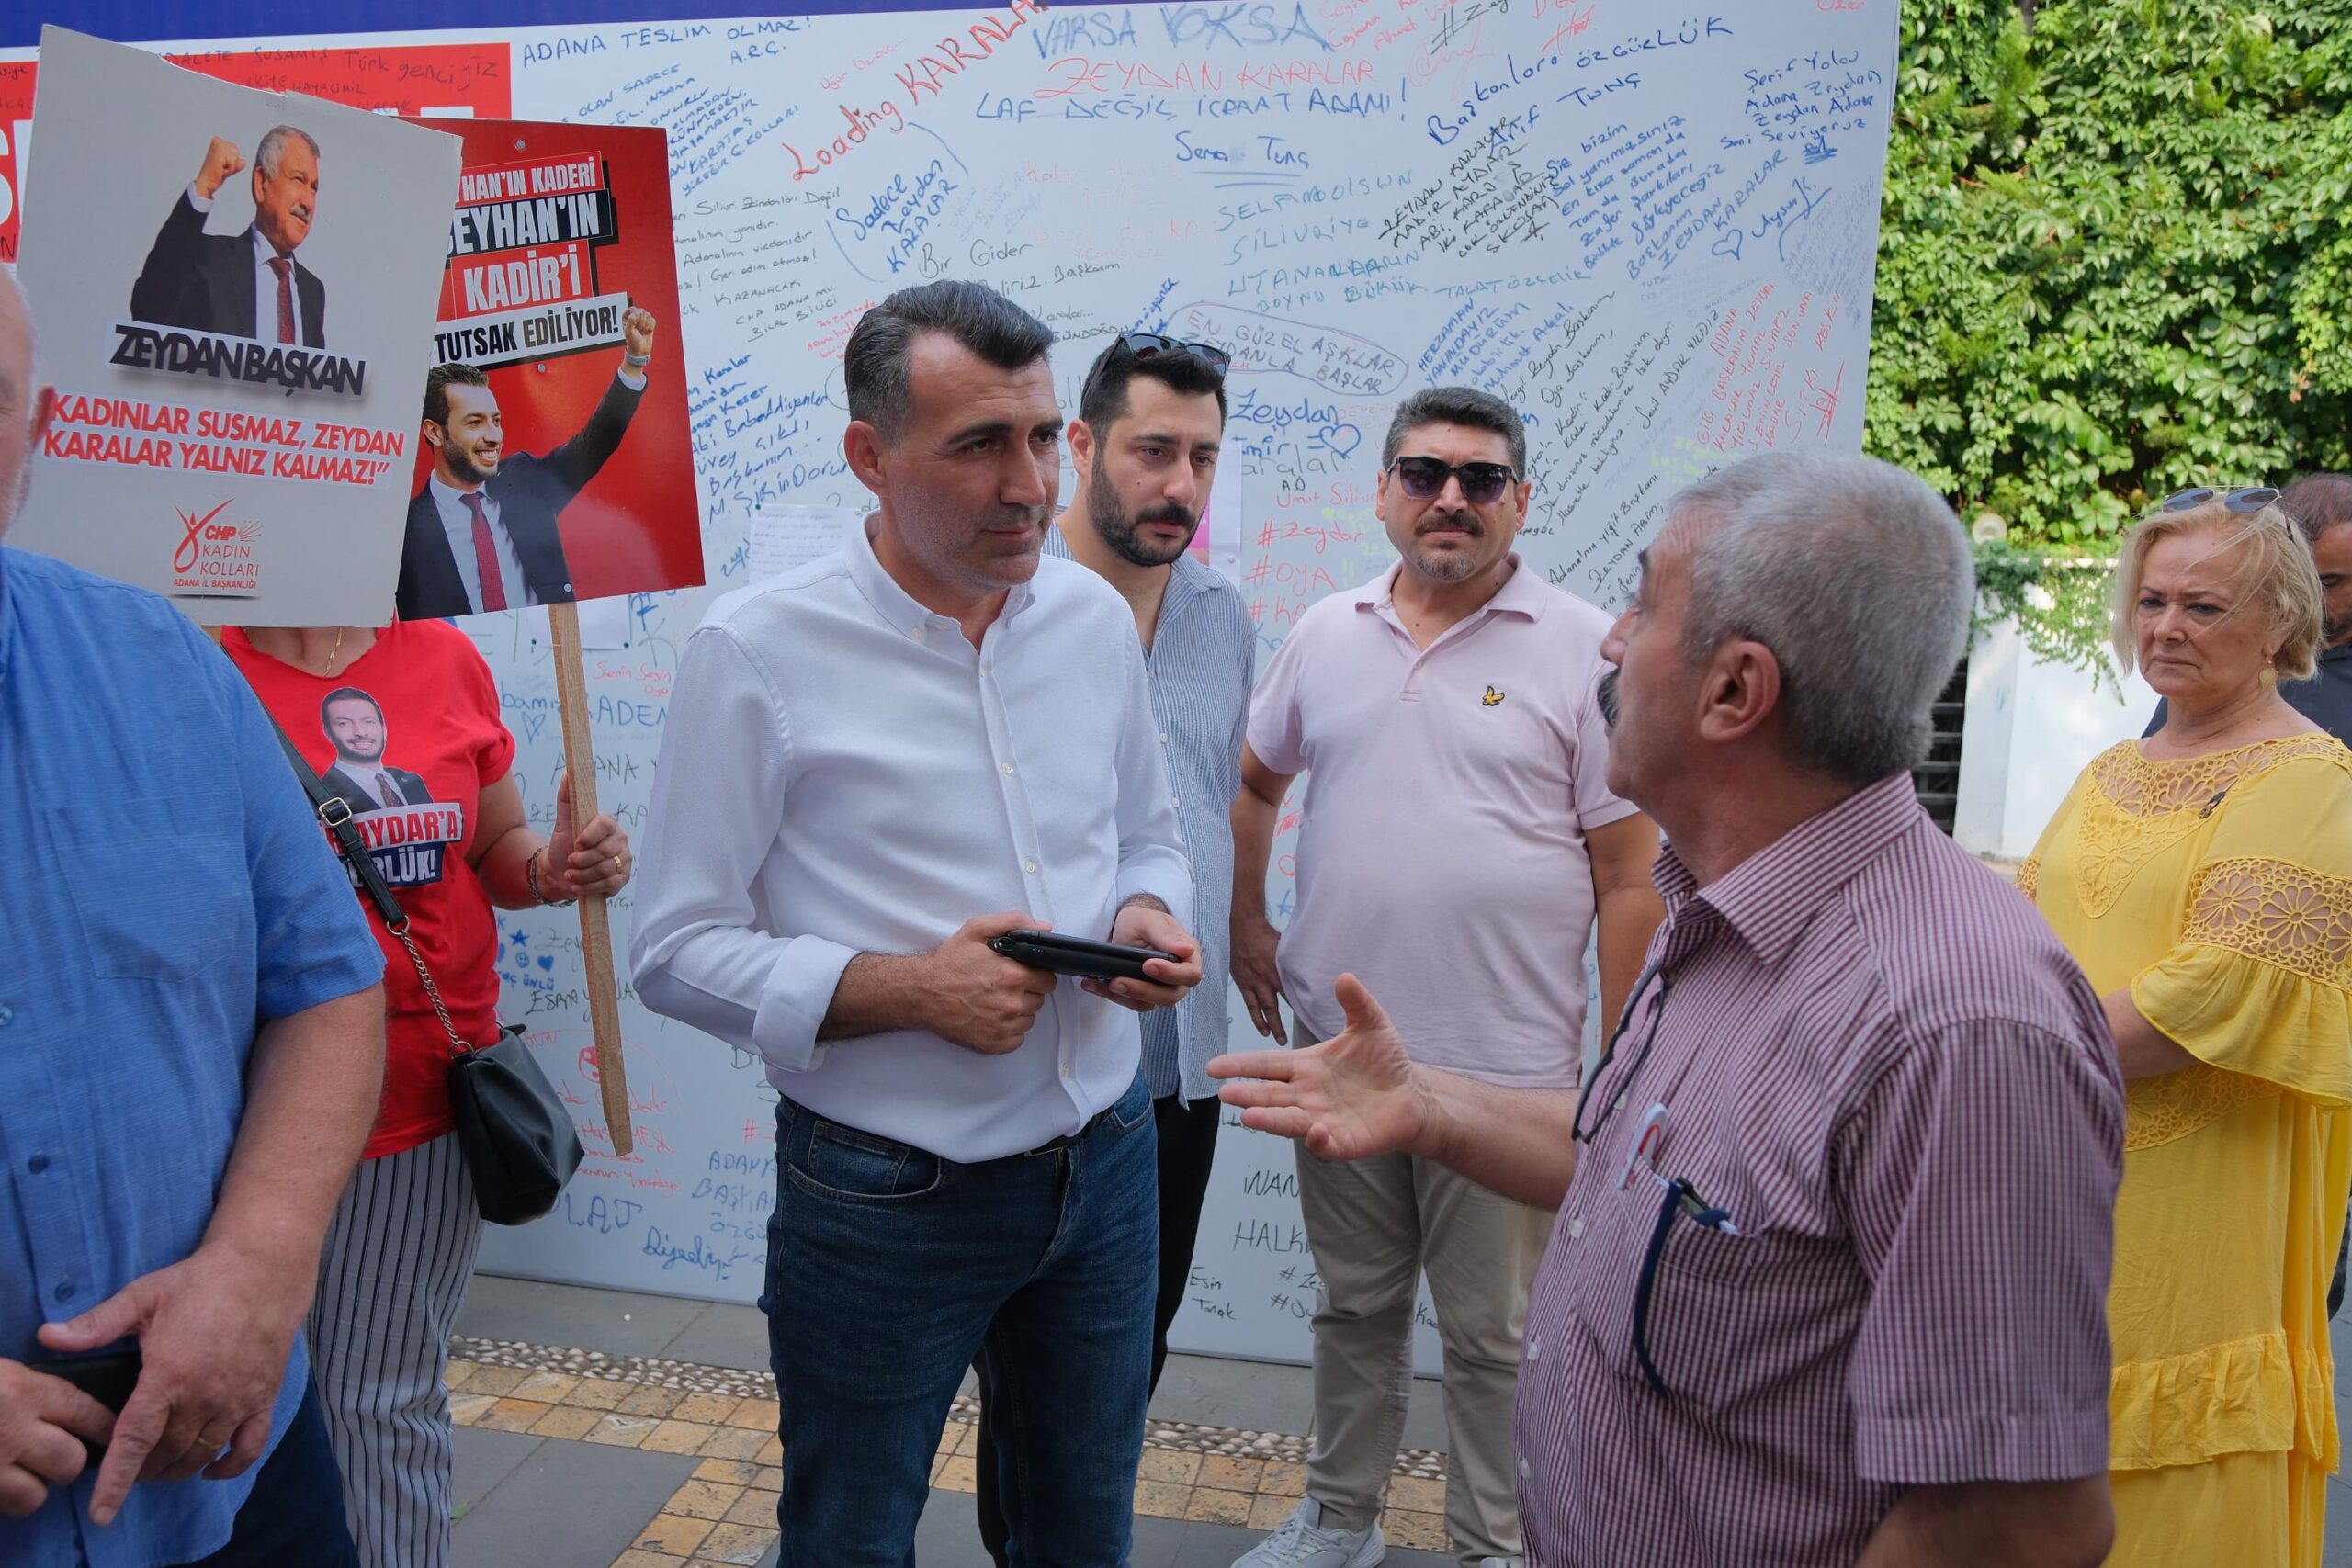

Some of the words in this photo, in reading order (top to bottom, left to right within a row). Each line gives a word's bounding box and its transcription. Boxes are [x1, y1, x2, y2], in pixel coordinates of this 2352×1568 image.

[522, 35, 606, 68] ADANA
[621, 25, 711, 49] TESLİM
[1031, 8, 1137, 59] VARSA
[345, 51, 390, 73] Türk
[1029, 58, 1223, 98] ZEYDAN
[1235, 58, 1377, 90] KARALAR
[781, 101, 905, 182] Loading
[894, 0, 1049, 107] KARALA
[975, 92, 1038, 124] LAF
[457, 169, 526, 202] HAN’IN
[531, 155, 596, 193] KADERİ
[463, 243, 582, 313] KADİR’İ
[434, 321, 518, 364] TUTSAK
[522, 304, 619, 348] EDİLİYOR!
[1187, 310, 1221, 337] EN
[1234, 324, 1305, 355] GÜZEL
[1311, 336, 1396, 378] AŞKLAR
[52, 394, 190, 436] KADINLAR
[198, 410, 306, 451] SUSMAZ,
[311, 423, 406, 457] ZEYDAN
[1228, 387, 1339, 436] Zeydan
[43, 429, 174, 468] KARALAR
[178, 443, 267, 477] YALNIZ
[202, 544, 251, 558] KADIN
[204, 525, 237, 541] CHP
[173, 578, 200, 588] ADANA
[211, 579, 257, 590] BAŞKANLIĞI
[199, 561, 260, 577] KOLLARI
[1232, 1218, 1314, 1254] HALK
